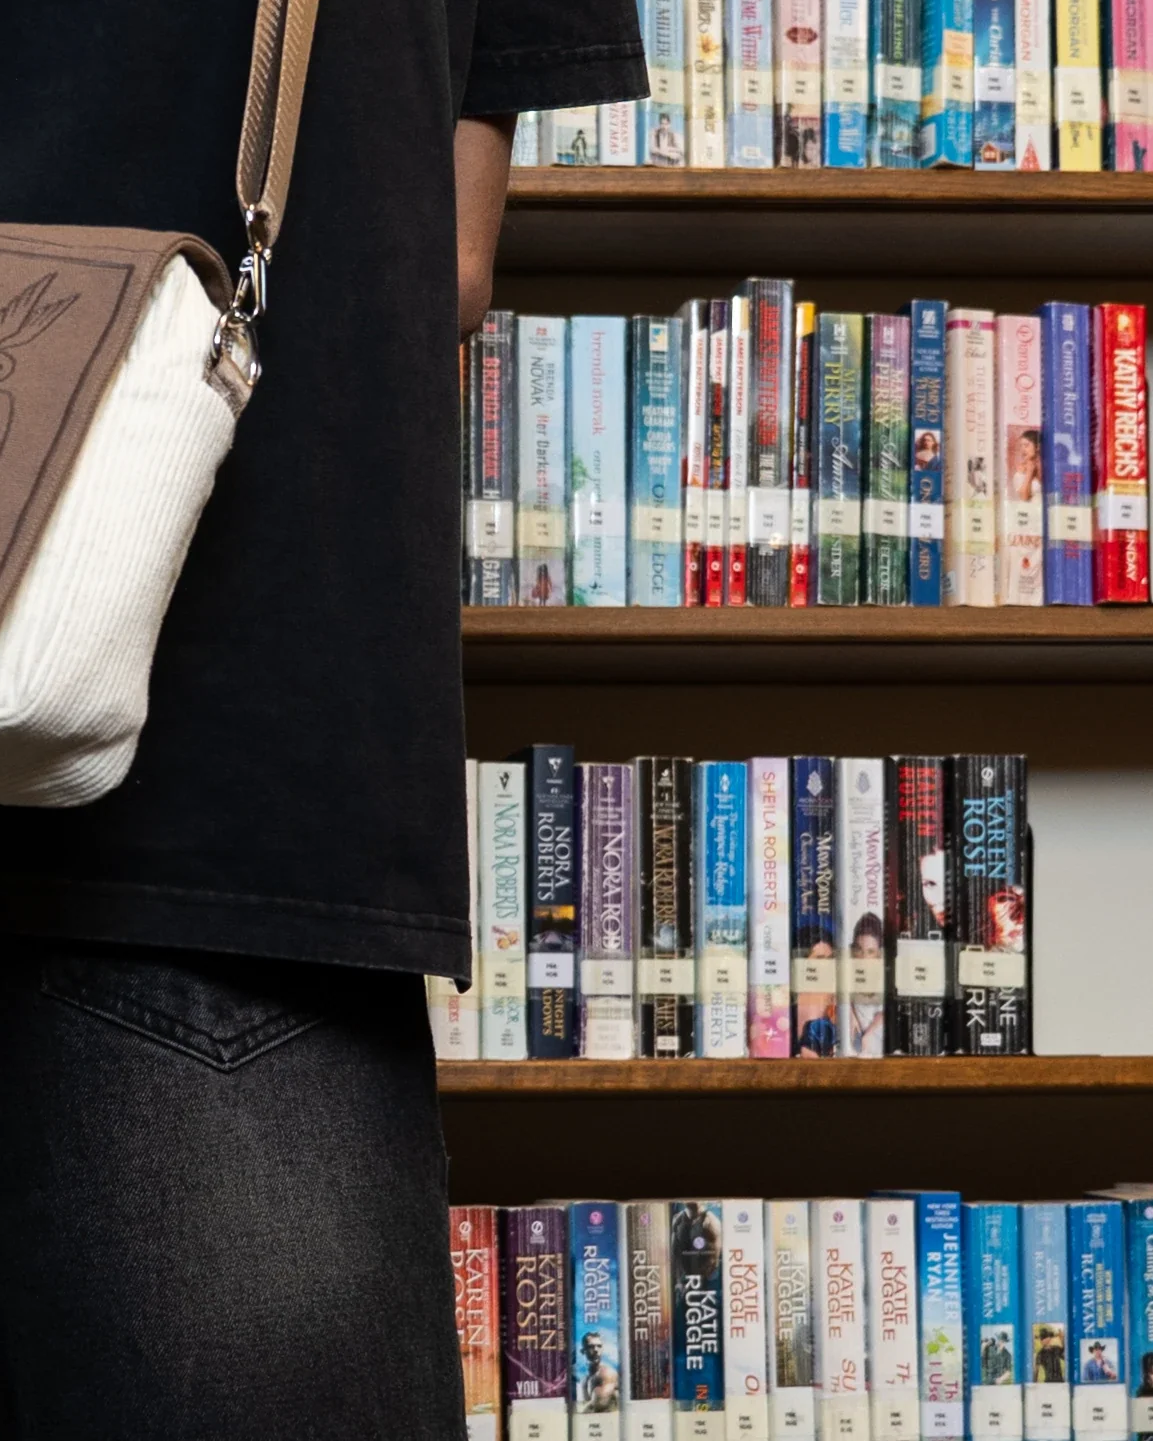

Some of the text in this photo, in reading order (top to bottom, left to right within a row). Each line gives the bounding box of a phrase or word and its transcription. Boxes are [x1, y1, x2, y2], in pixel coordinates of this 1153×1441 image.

[656, 8, 670, 57] MILLER
[530, 355, 544, 407] NOVAK
[546, 363, 555, 401] BRENDA
[758, 301, 778, 446] JAMES PATTERSON
[1016, 324, 1035, 373] Diana
[591, 331, 605, 435] brenda novak
[825, 361, 842, 428] PERRY
[843, 369, 856, 423] MARTA
[875, 362, 890, 429] PERRY
[1114, 348, 1138, 476] KATHY REICHS
[482, 356, 500, 479] BRENDA NOVAK
[593, 450, 603, 474] one
[482, 560, 500, 598] GAIN
[651, 553, 665, 595] EDGE
[538, 812, 554, 901] ROBERTS
[555, 826, 570, 887] NORA
[964, 798, 985, 877] ROSE
[987, 796, 1004, 879] KAREN
[465, 1248, 484, 1345] KAREN
[516, 1256, 537, 1350] ROSE
[539, 1253, 556, 1350] KAREN
[633, 1250, 647, 1341] RUGGLE
[647, 1265, 660, 1324] KATIE
[927, 1252, 942, 1302] RYAN
[944, 1232, 958, 1320] JENNIFER
[685, 1275, 702, 1370] RUGGLE
[702, 1290, 716, 1353] KATIE
[517, 1381, 538, 1395] YOU
[696, 1385, 707, 1400] IN
